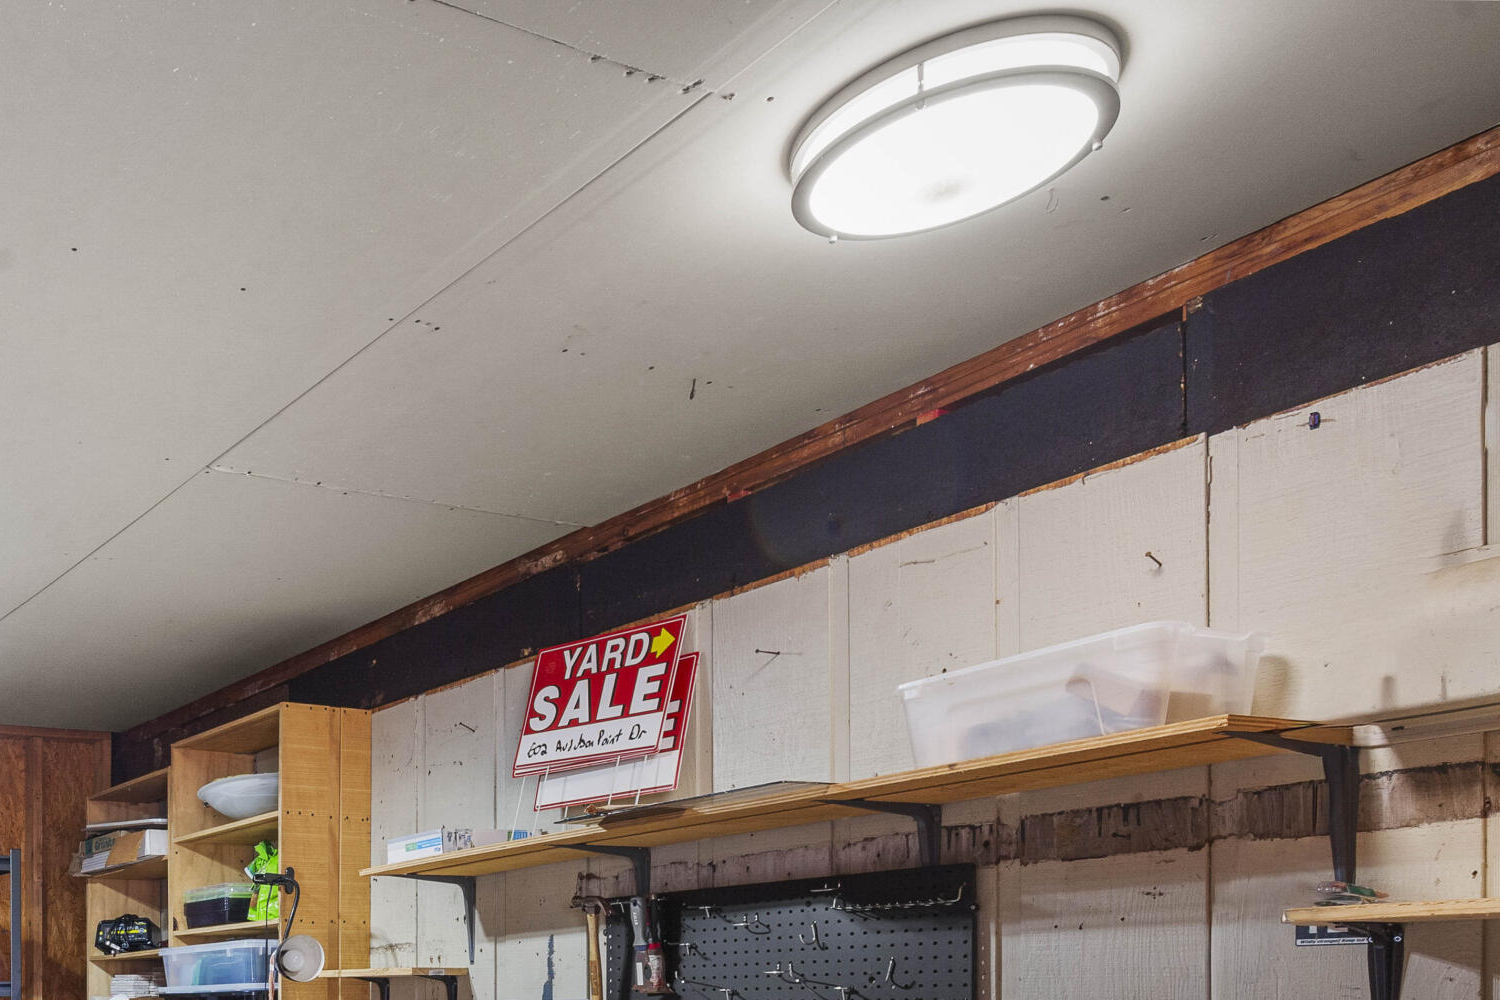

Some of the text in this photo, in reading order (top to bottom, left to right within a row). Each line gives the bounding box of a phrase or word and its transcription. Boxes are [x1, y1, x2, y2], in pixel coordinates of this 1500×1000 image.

[563, 632, 650, 680] YARD
[529, 662, 668, 732] SALE
[597, 729, 623, 746] Point
[629, 723, 647, 741] Dr
